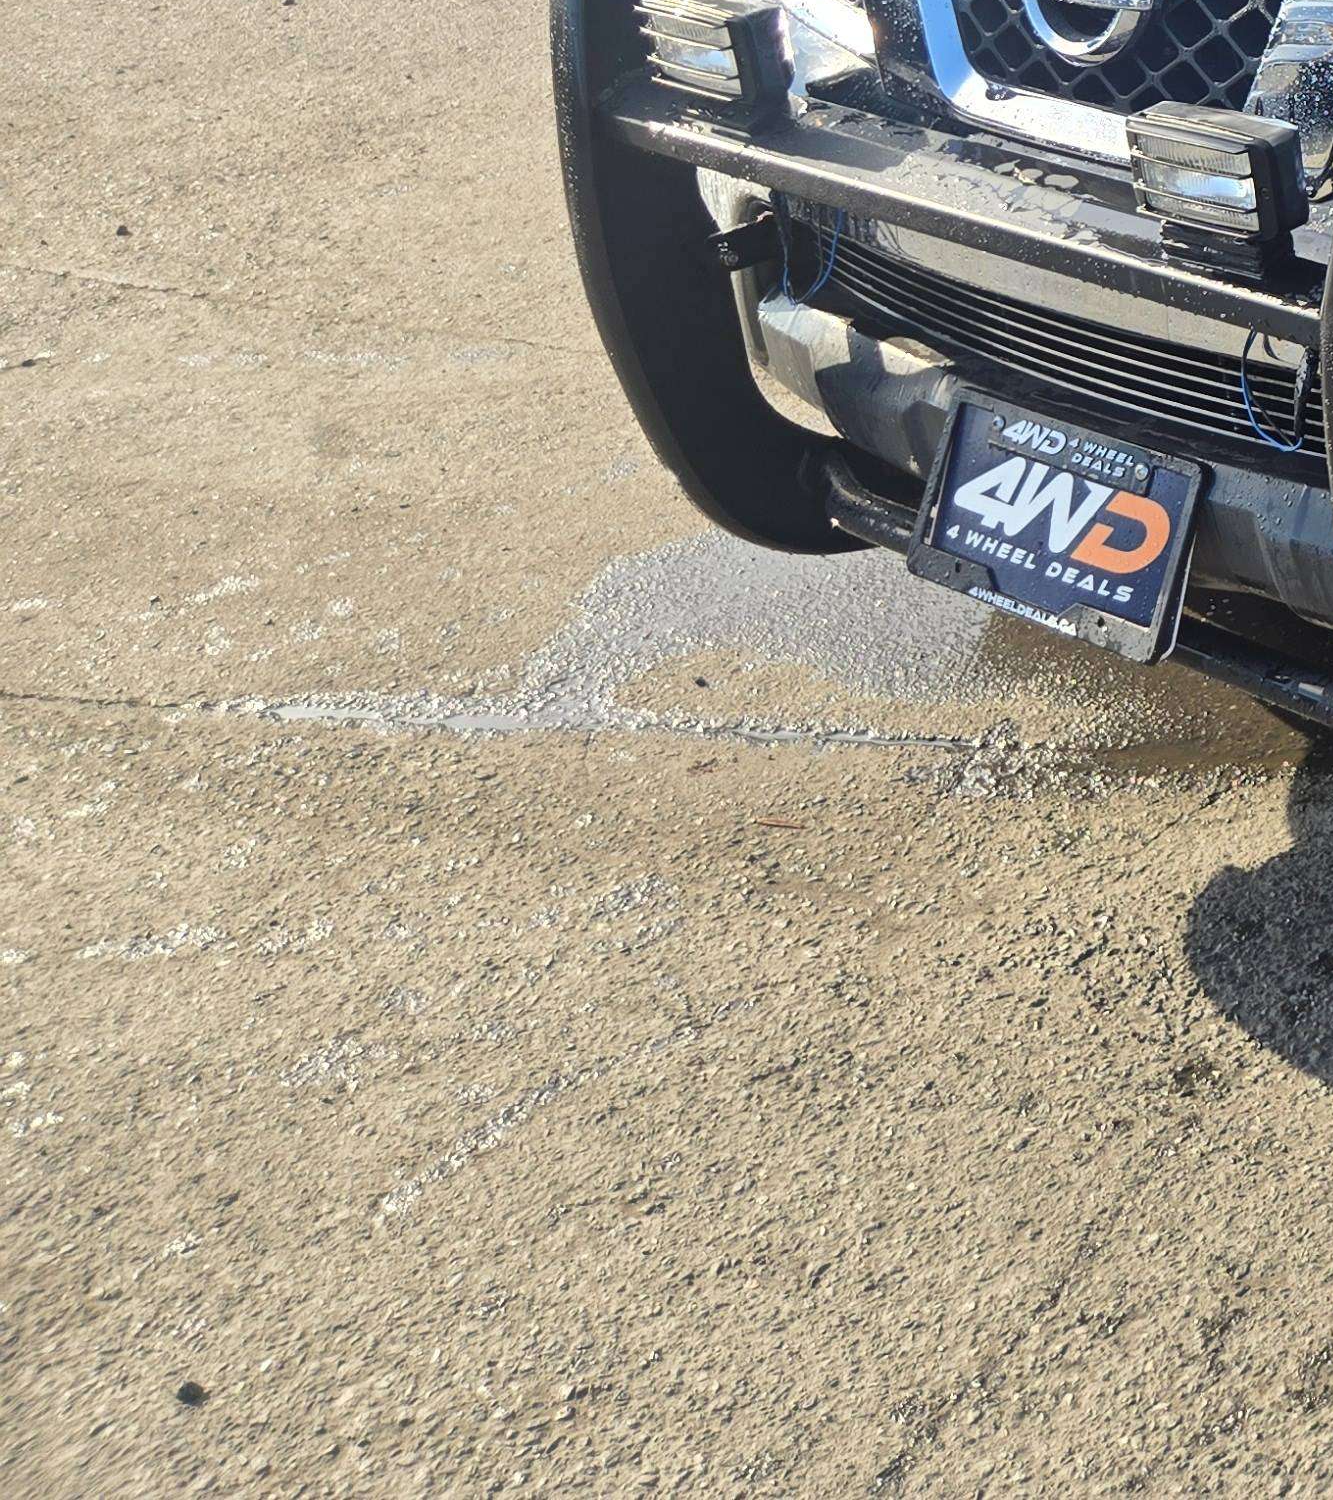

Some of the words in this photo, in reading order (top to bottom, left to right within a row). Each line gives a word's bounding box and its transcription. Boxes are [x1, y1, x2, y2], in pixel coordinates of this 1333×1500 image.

[1002, 419, 1068, 455] 4WD
[1068, 438, 1081, 449] 4
[1083, 441, 1135, 466] WHEEL
[1071, 452, 1126, 478] DEALS
[953, 456, 1171, 575] 4WD
[946, 524, 960, 540] 4
[963, 530, 1036, 570] WHEEL
[1045, 562, 1134, 603] DEALS
